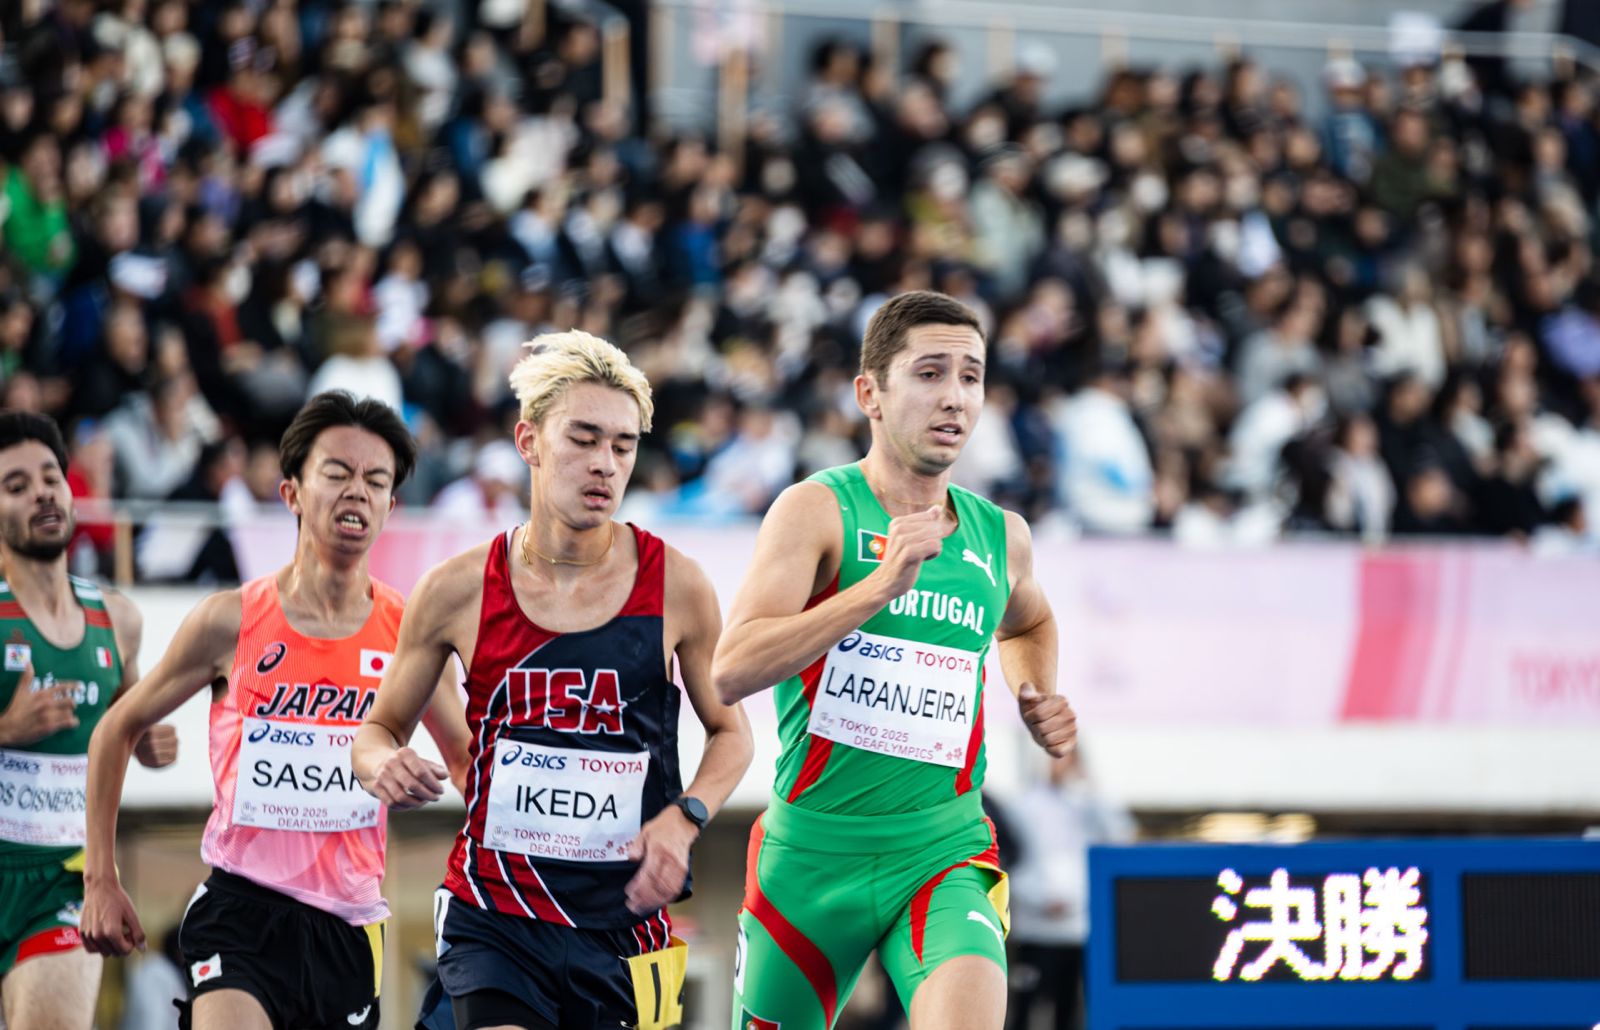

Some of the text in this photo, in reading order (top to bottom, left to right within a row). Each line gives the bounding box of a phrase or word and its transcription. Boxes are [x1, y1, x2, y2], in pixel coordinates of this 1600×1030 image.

[888, 588, 985, 636] ORTUGAL
[915, 651, 973, 674] TOYOTA
[506, 668, 628, 735] USA
[825, 666, 967, 724] LARANJEIRA
[838, 718, 879, 737] TOKYO
[881, 728, 910, 743] 2025
[853, 735, 934, 761] DEAFLYMPICS
[579, 757, 644, 775] TOYOTA
[262, 803, 328, 818] TOKYO 2025
[515, 785, 618, 821] IKEDA
[277, 817, 351, 830] DEAFLYMPICS
[514, 828, 581, 847] TOKYO 2025
[529, 842, 607, 860] DEAFLYMPICS
[1211, 866, 1429, 982] 決勝
